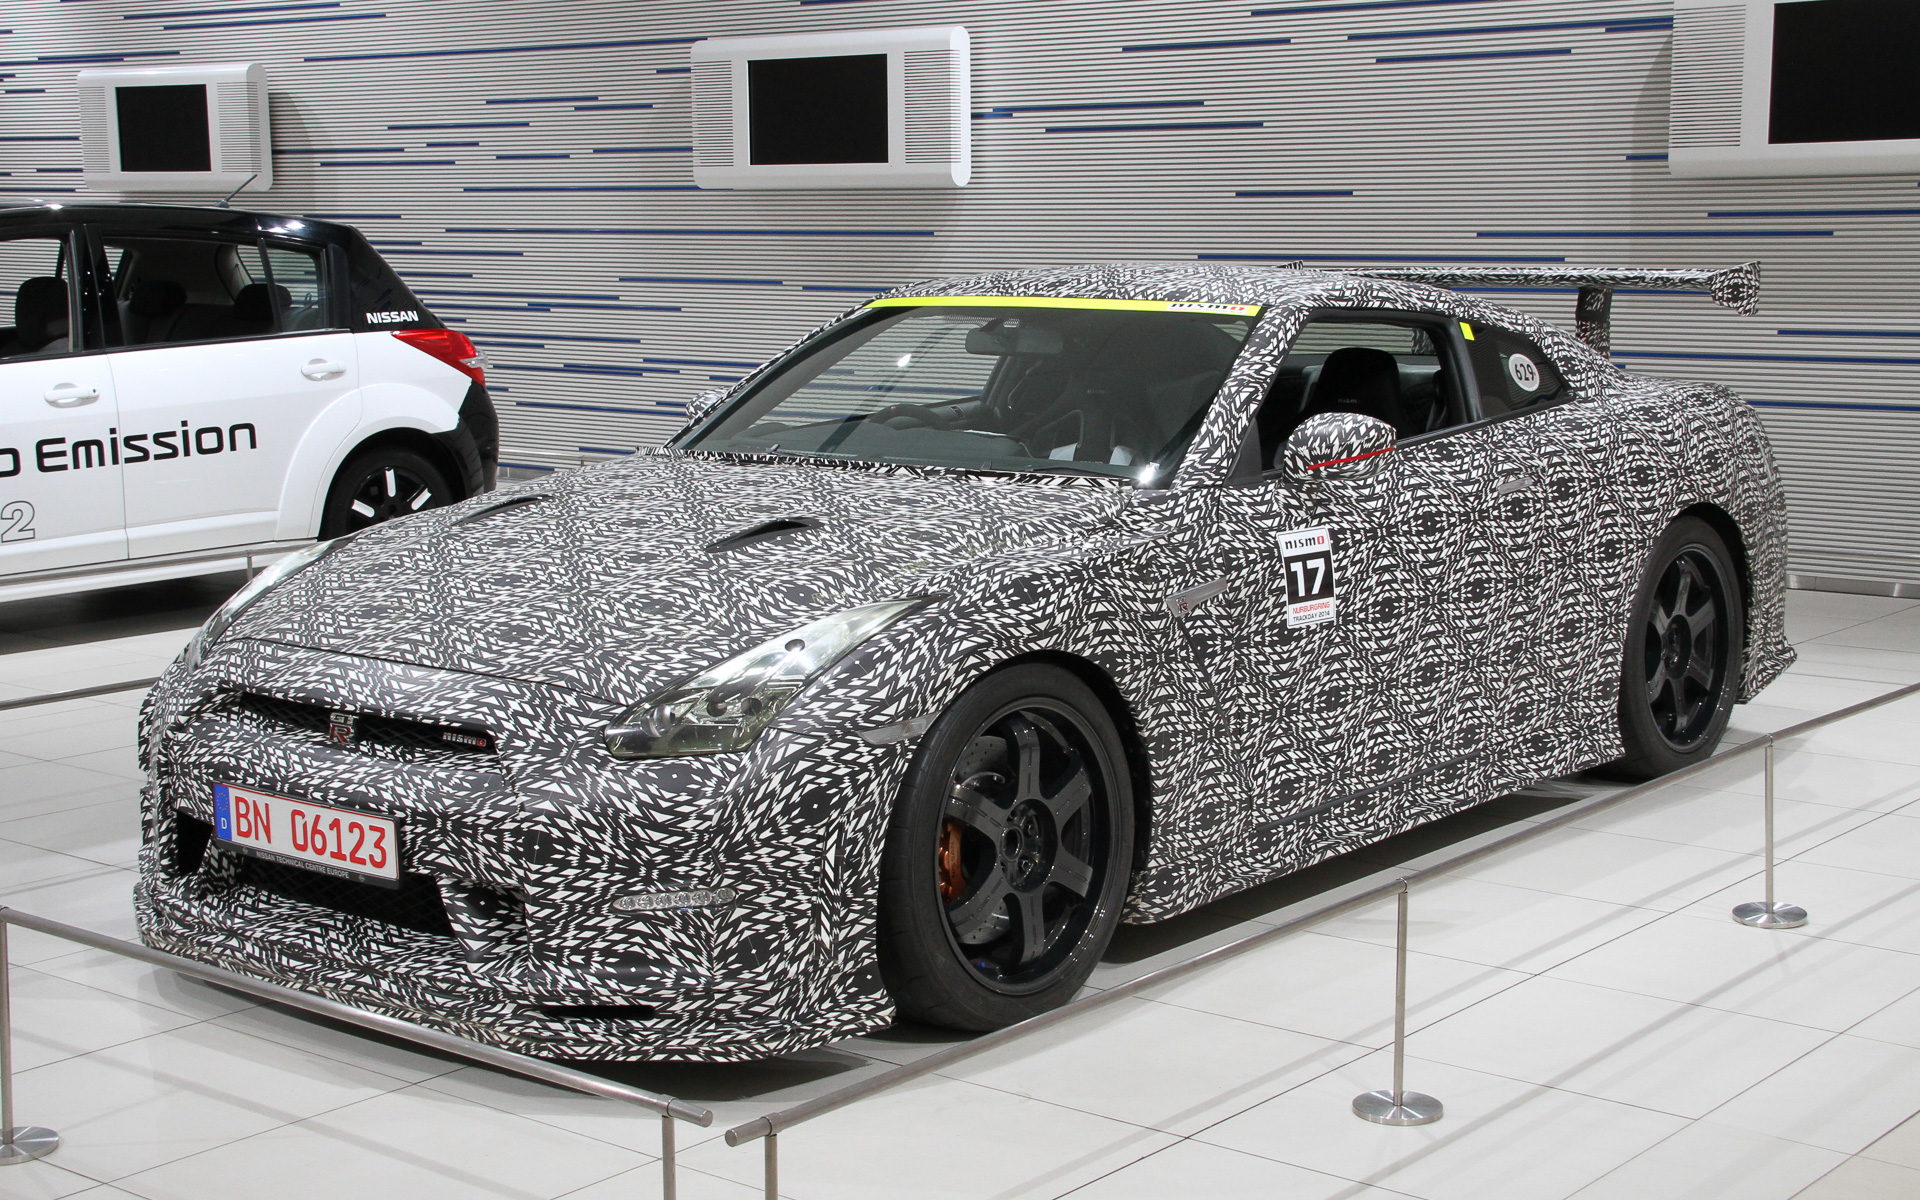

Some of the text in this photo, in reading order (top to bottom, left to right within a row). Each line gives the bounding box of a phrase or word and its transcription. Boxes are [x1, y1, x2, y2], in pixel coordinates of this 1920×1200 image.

[365, 310, 419, 324] NISSAN
[1514, 363, 1534, 381] 629
[35, 420, 257, 473] Emission
[1, 500, 36, 544] 2
[1285, 535, 1325, 550] nismo
[1290, 558, 1326, 597] 17
[1293, 601, 1330, 615] NURBURGRING
[1293, 610, 1330, 622] TRACKDAY 2014
[443, 732, 487, 747] nismo
[221, 817, 228, 830] D
[235, 795, 387, 869] BN 06123
[256, 851, 350, 879] NISSAN TECHNICAL CENTRE EUROPE
